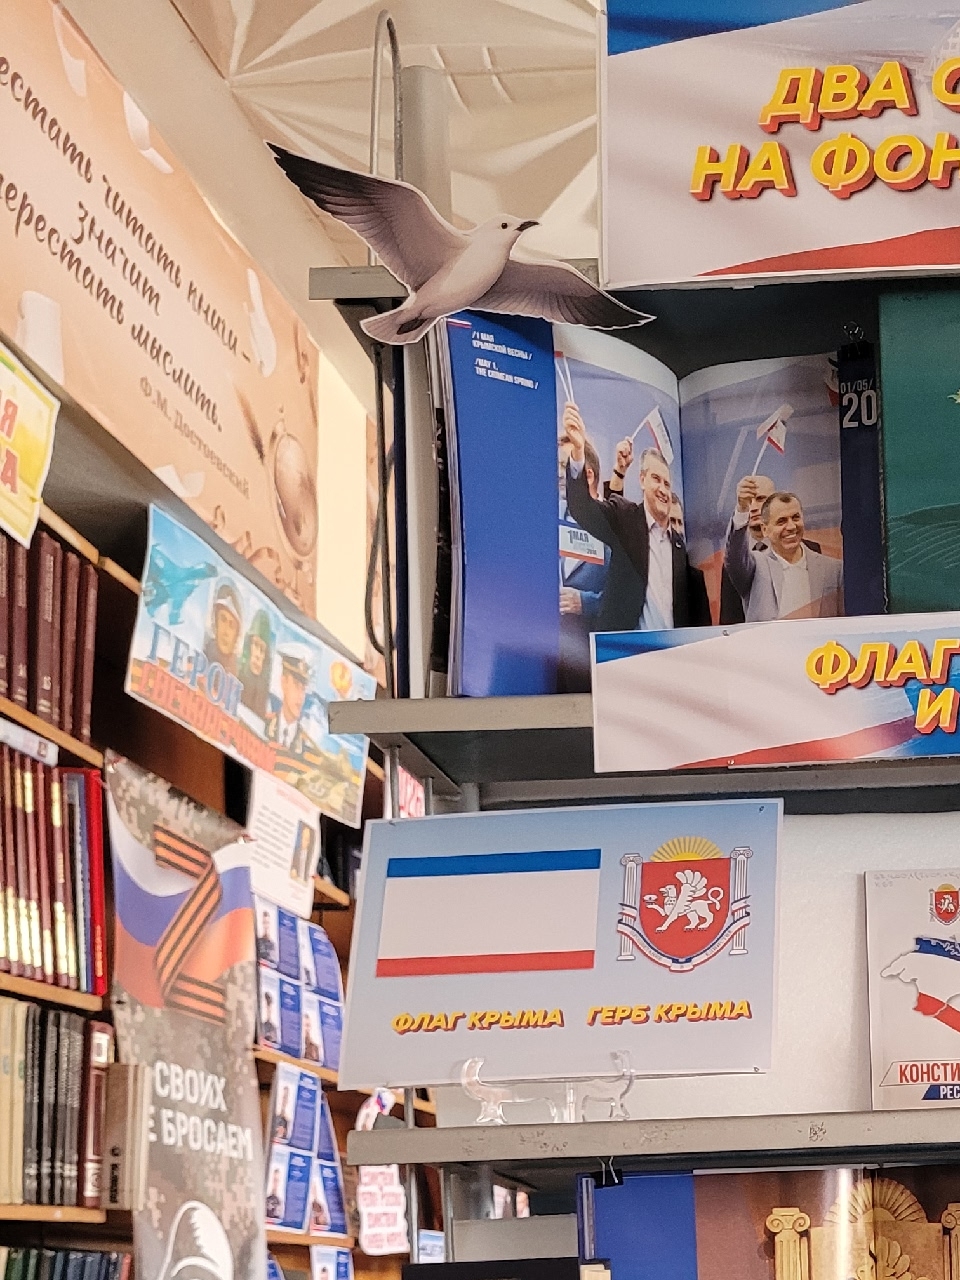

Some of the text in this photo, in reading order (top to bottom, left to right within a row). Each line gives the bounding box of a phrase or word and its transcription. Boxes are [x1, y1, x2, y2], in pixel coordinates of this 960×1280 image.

[759, 60, 918, 132] ДВА
[690, 141, 797, 200] НА
[73, 201, 160, 317] Значит
[102, 174, 183, 287] читать
[187, 281, 238, 354] книги
[0, 172, 223, 432] ерестать мыслить.
[840, 378, 874, 394] 01/05/
[842, 389, 878, 429] 20
[915, 686, 958, 733] И
[391, 1008, 565, 1035] ФЛАГ КРЫМА
[586, 999, 752, 1027] ГЕРБ КРЫМА
[155, 1060, 227, 1112] СВОИХ
[161, 1108, 254, 1161] БРОСАЕМ
